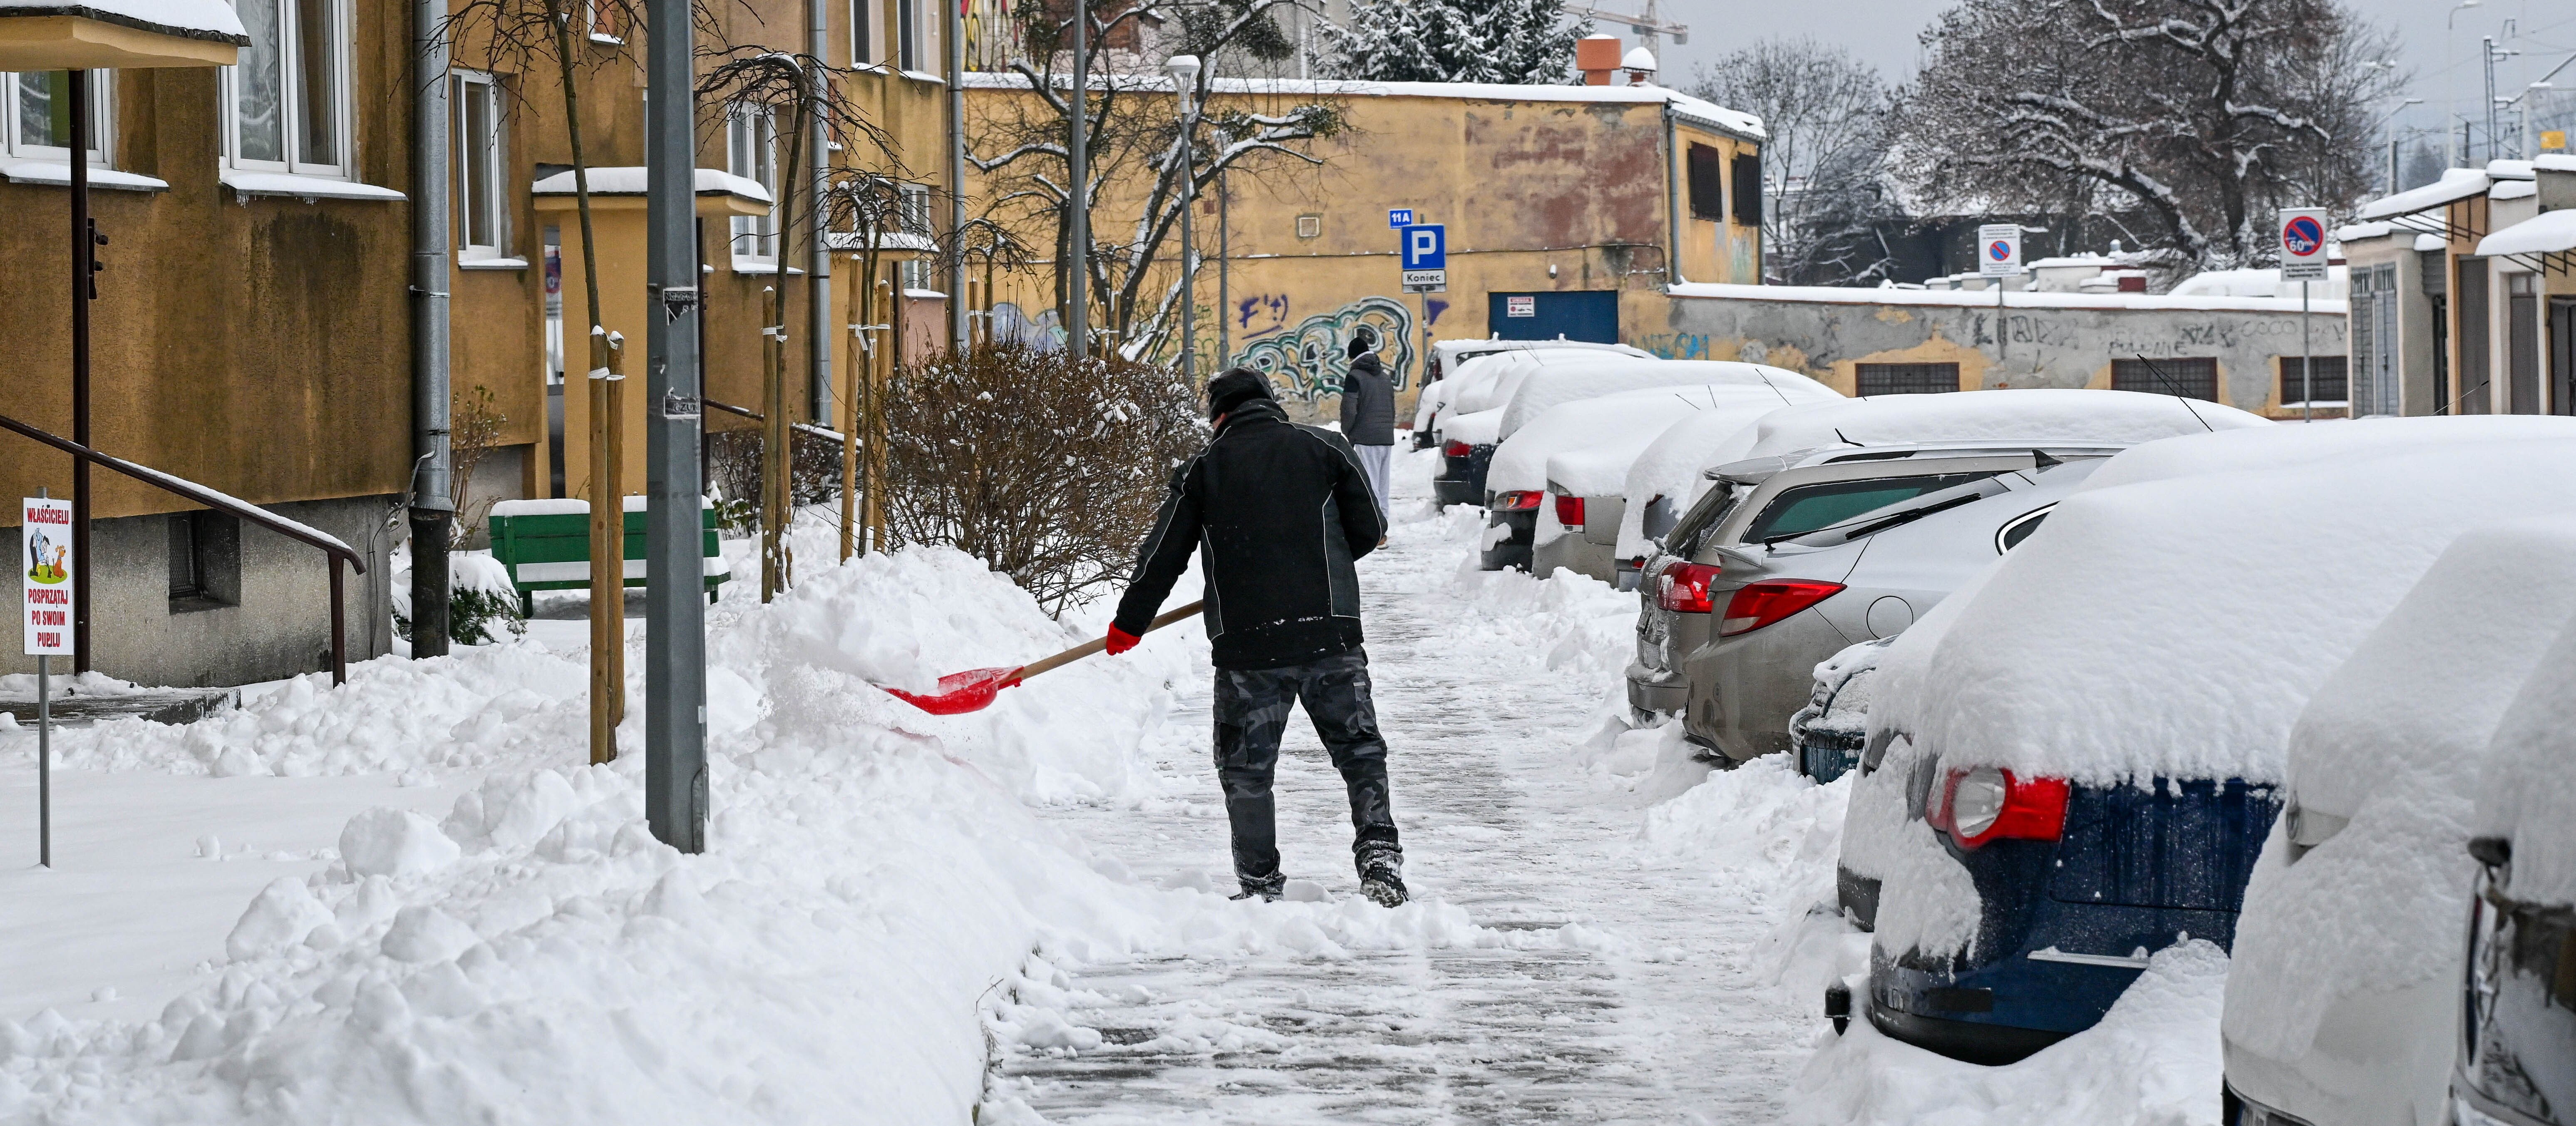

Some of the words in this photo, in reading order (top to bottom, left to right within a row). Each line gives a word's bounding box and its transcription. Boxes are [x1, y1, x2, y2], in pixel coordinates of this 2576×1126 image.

[1391, 213, 1410, 222] 11A
[1412, 231, 1436, 264] P
[1407, 273, 1440, 282] Koniec
[27, 505, 69, 525] WŁAŚCICIELU
[28, 589, 68, 608] POSPRZĄTAJ
[32, 610, 40, 625] PO
[43, 611, 65, 625] SWOIM
[37, 632, 60, 647] PUPILU
